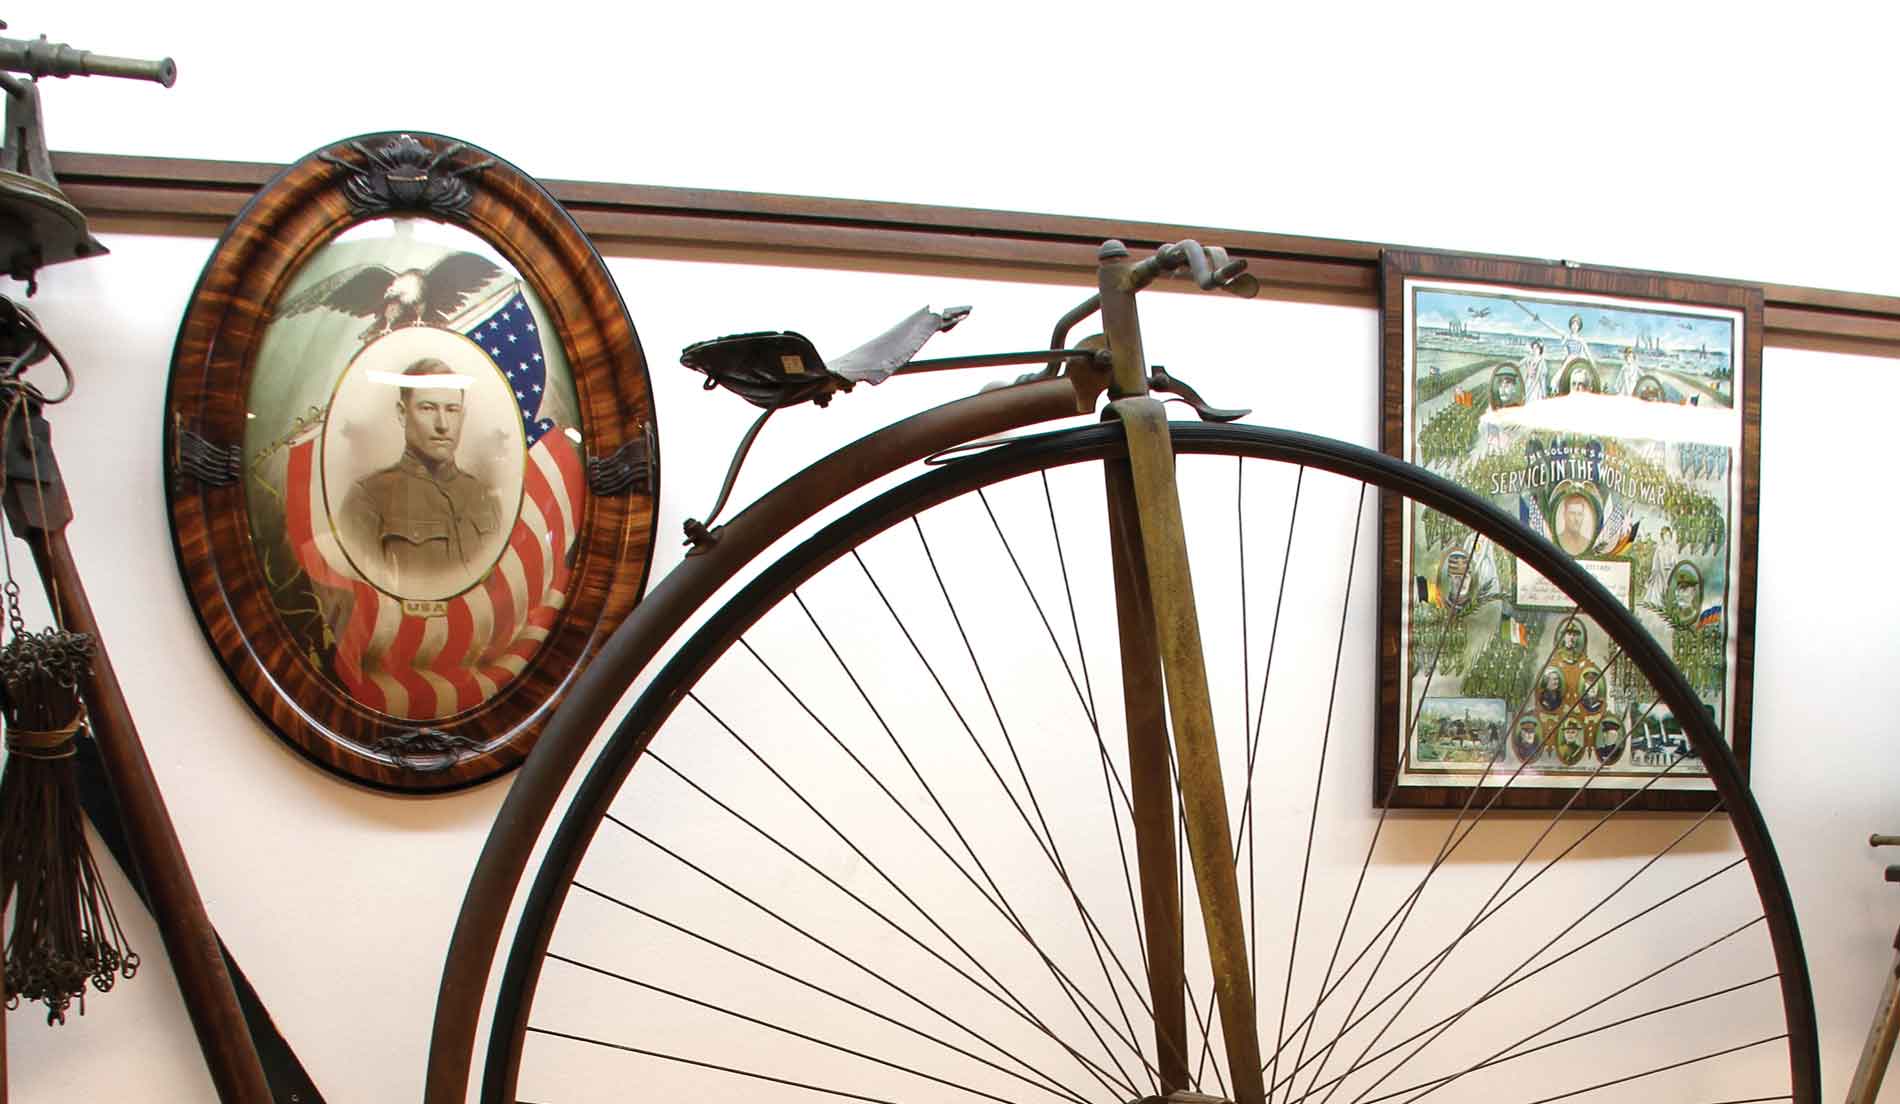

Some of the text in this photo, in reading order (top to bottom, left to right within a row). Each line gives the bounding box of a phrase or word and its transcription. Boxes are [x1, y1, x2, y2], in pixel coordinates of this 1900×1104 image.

[1524, 450, 1542, 464] THE
[1491, 463, 1546, 494] SERVICE
[1551, 460, 1566, 482] IN
[1568, 459, 1593, 481] THE
[1598, 462, 1637, 498] WORLD
[1640, 480, 1666, 505] WAR
